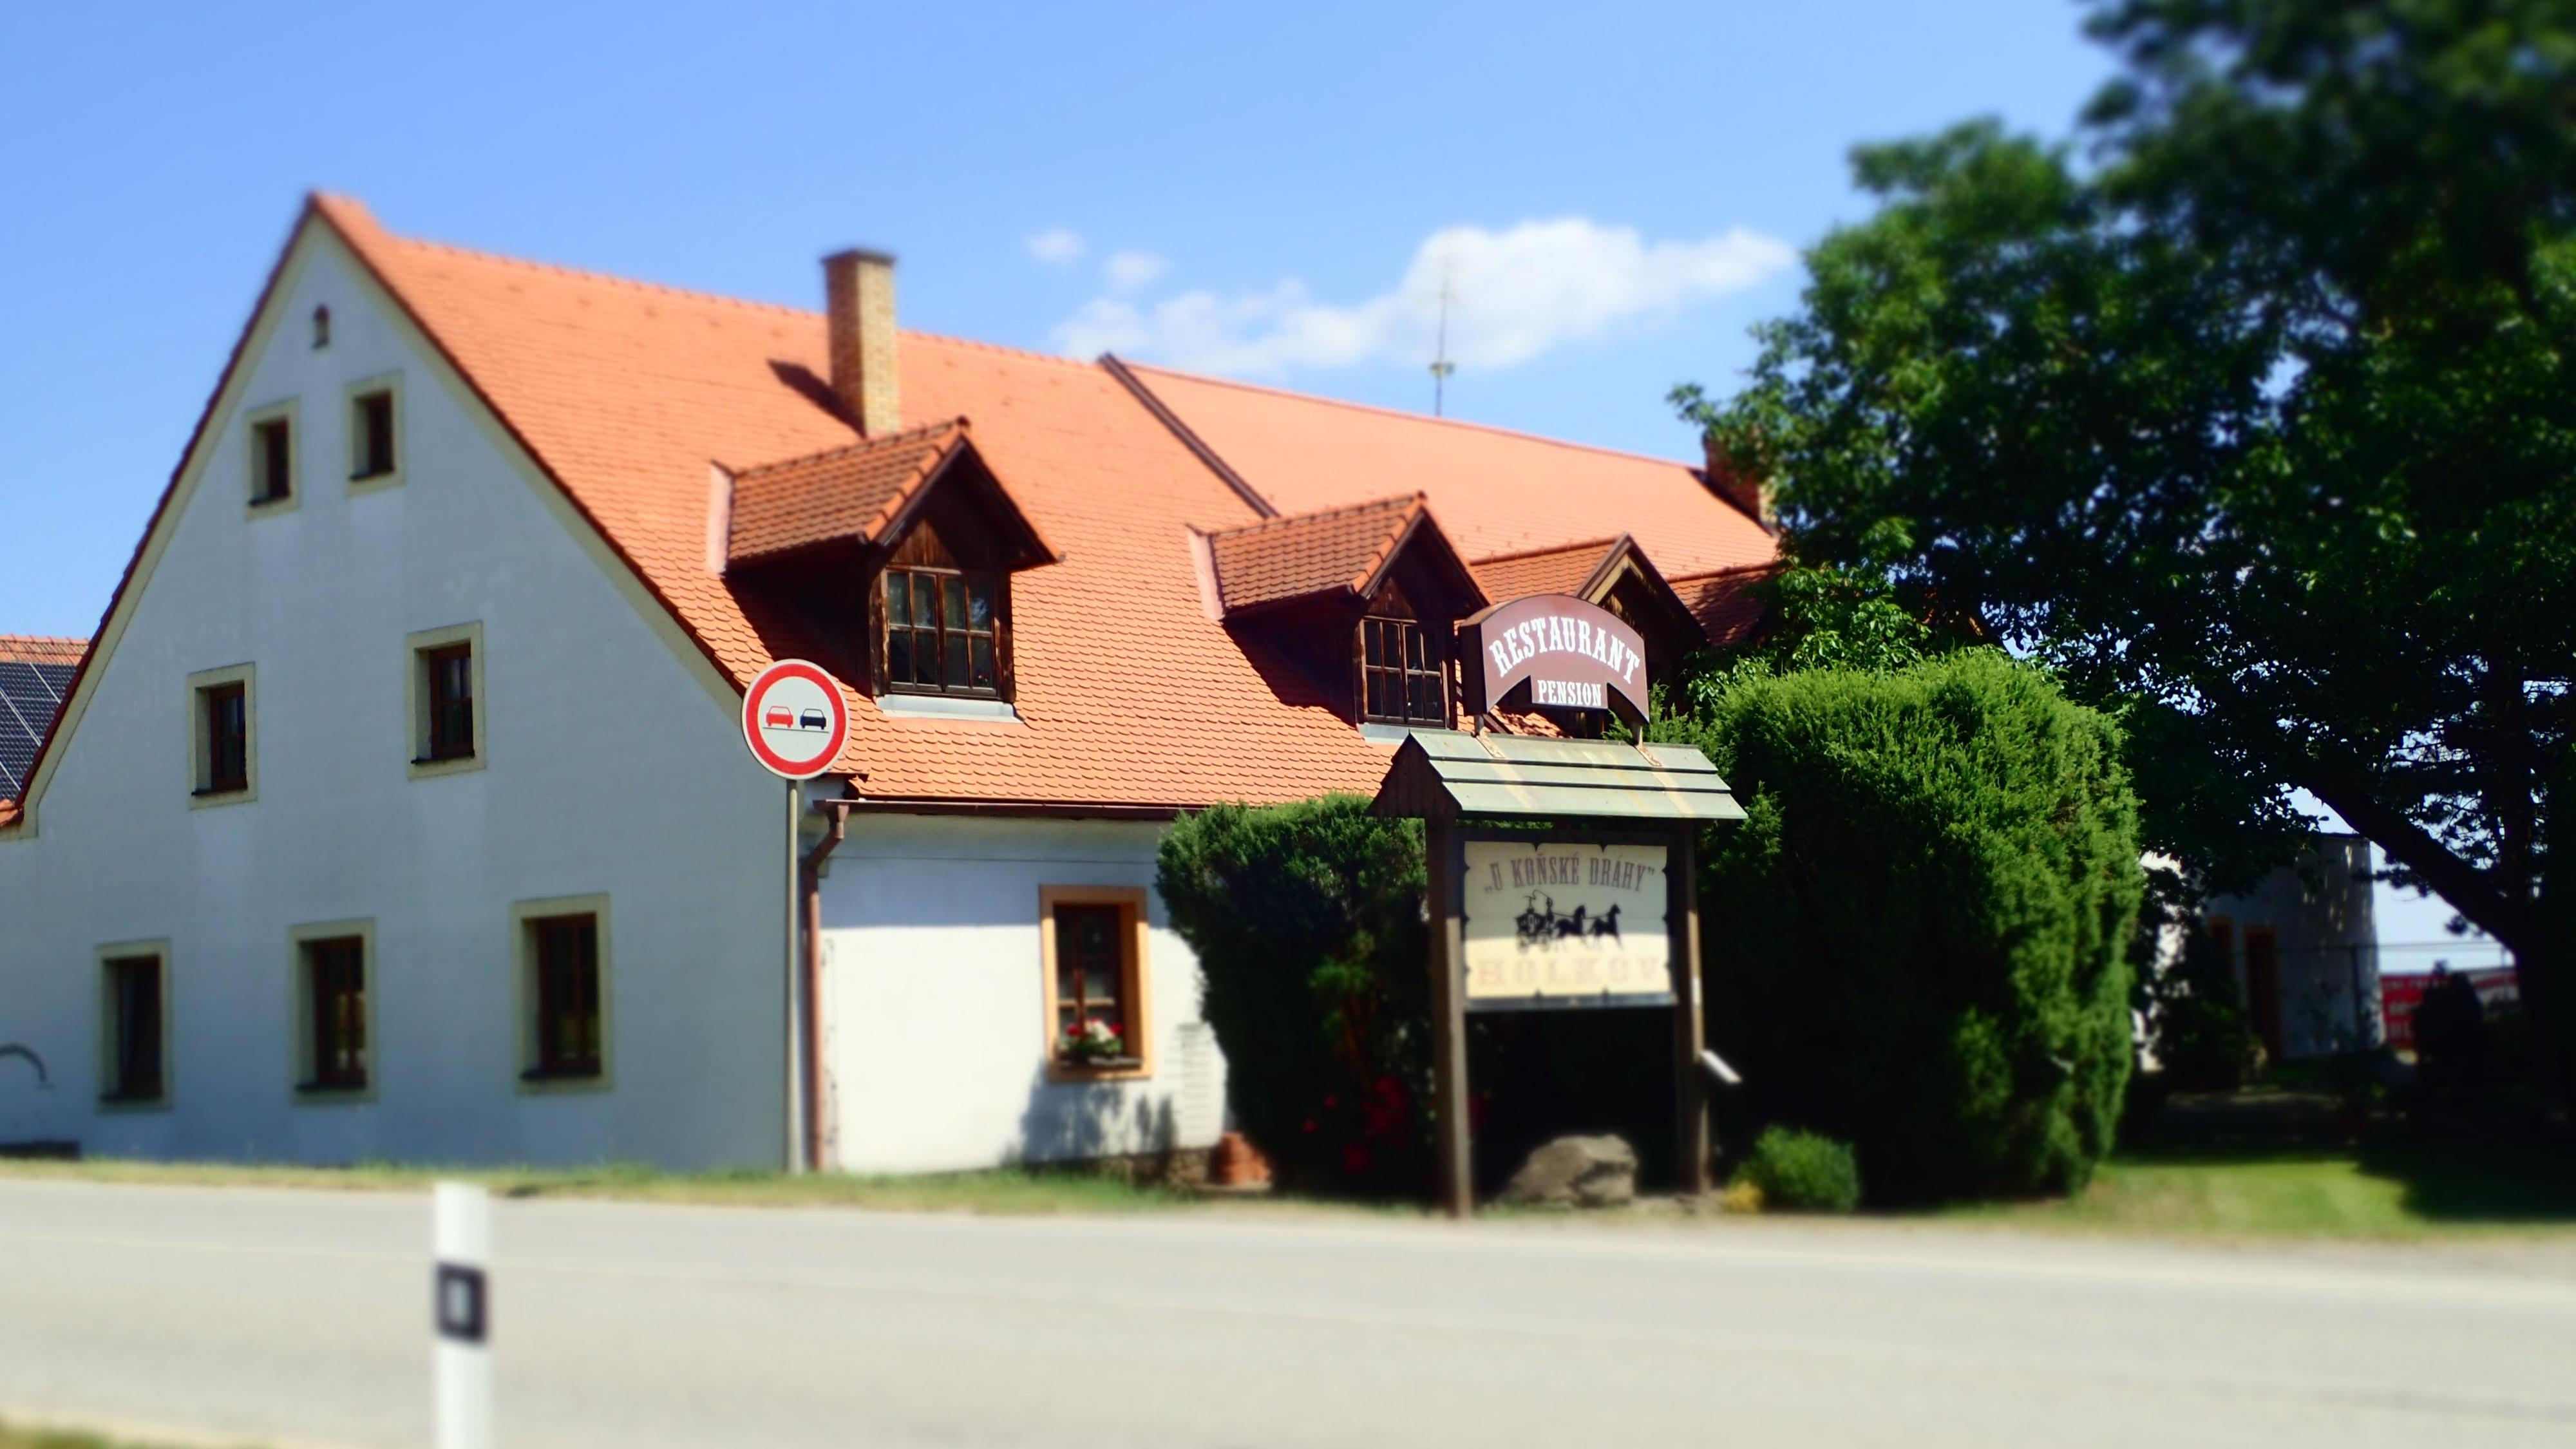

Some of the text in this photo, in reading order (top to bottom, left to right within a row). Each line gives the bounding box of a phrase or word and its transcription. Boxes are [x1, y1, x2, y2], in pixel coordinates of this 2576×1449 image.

[1488, 616, 1640, 685] RESTAURANT
[1537, 679, 1602, 706] PENSION
[1511, 852, 1580, 888] KOŇSKÉ
